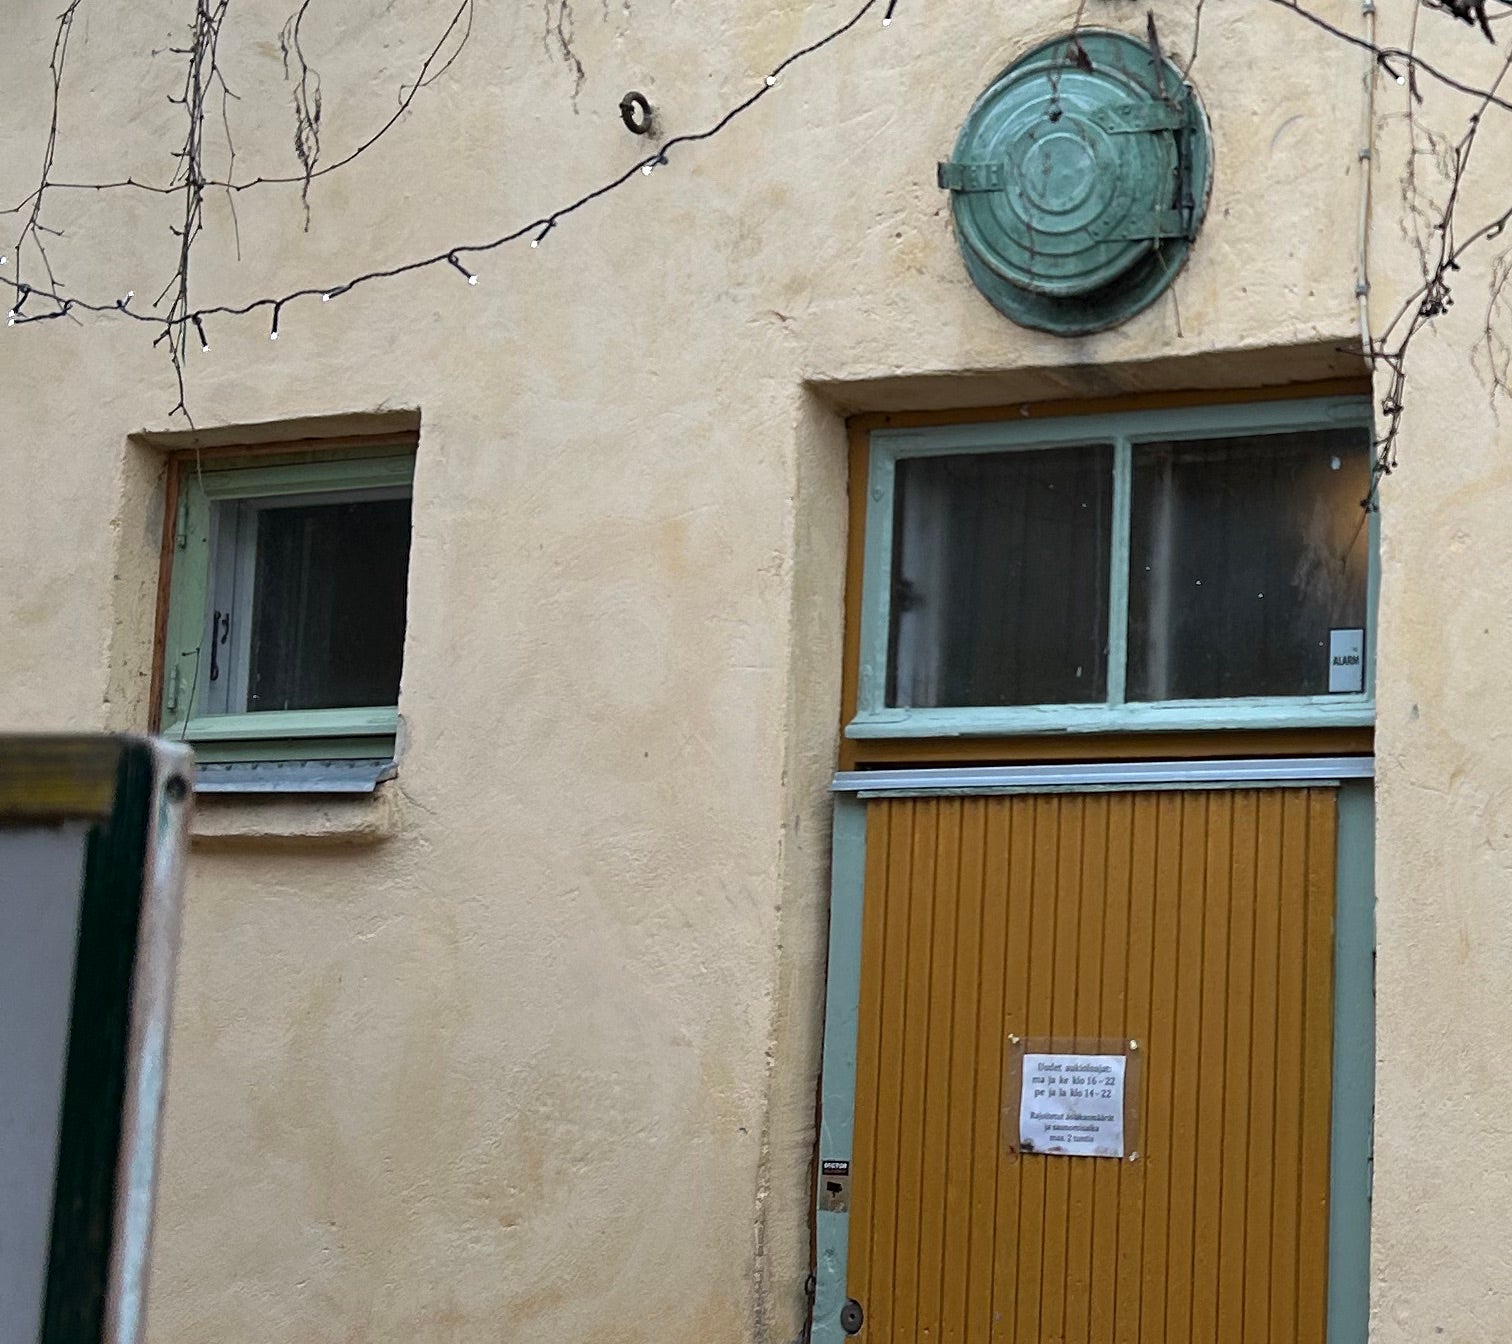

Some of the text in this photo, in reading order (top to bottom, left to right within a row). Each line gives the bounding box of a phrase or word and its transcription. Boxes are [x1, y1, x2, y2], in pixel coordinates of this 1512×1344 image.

[1332, 655, 1360, 666] ALARM
[1038, 1062, 1063, 1072] Uudet
[1032, 1076, 1045, 1084] ma
[1048, 1076, 1056, 1085] ja
[1072, 1076, 1086, 1085] klo
[1034, 1088, 1045, 1098] pe
[1048, 1088, 1056, 1098] ja
[1070, 1088, 1083, 1097] klo
